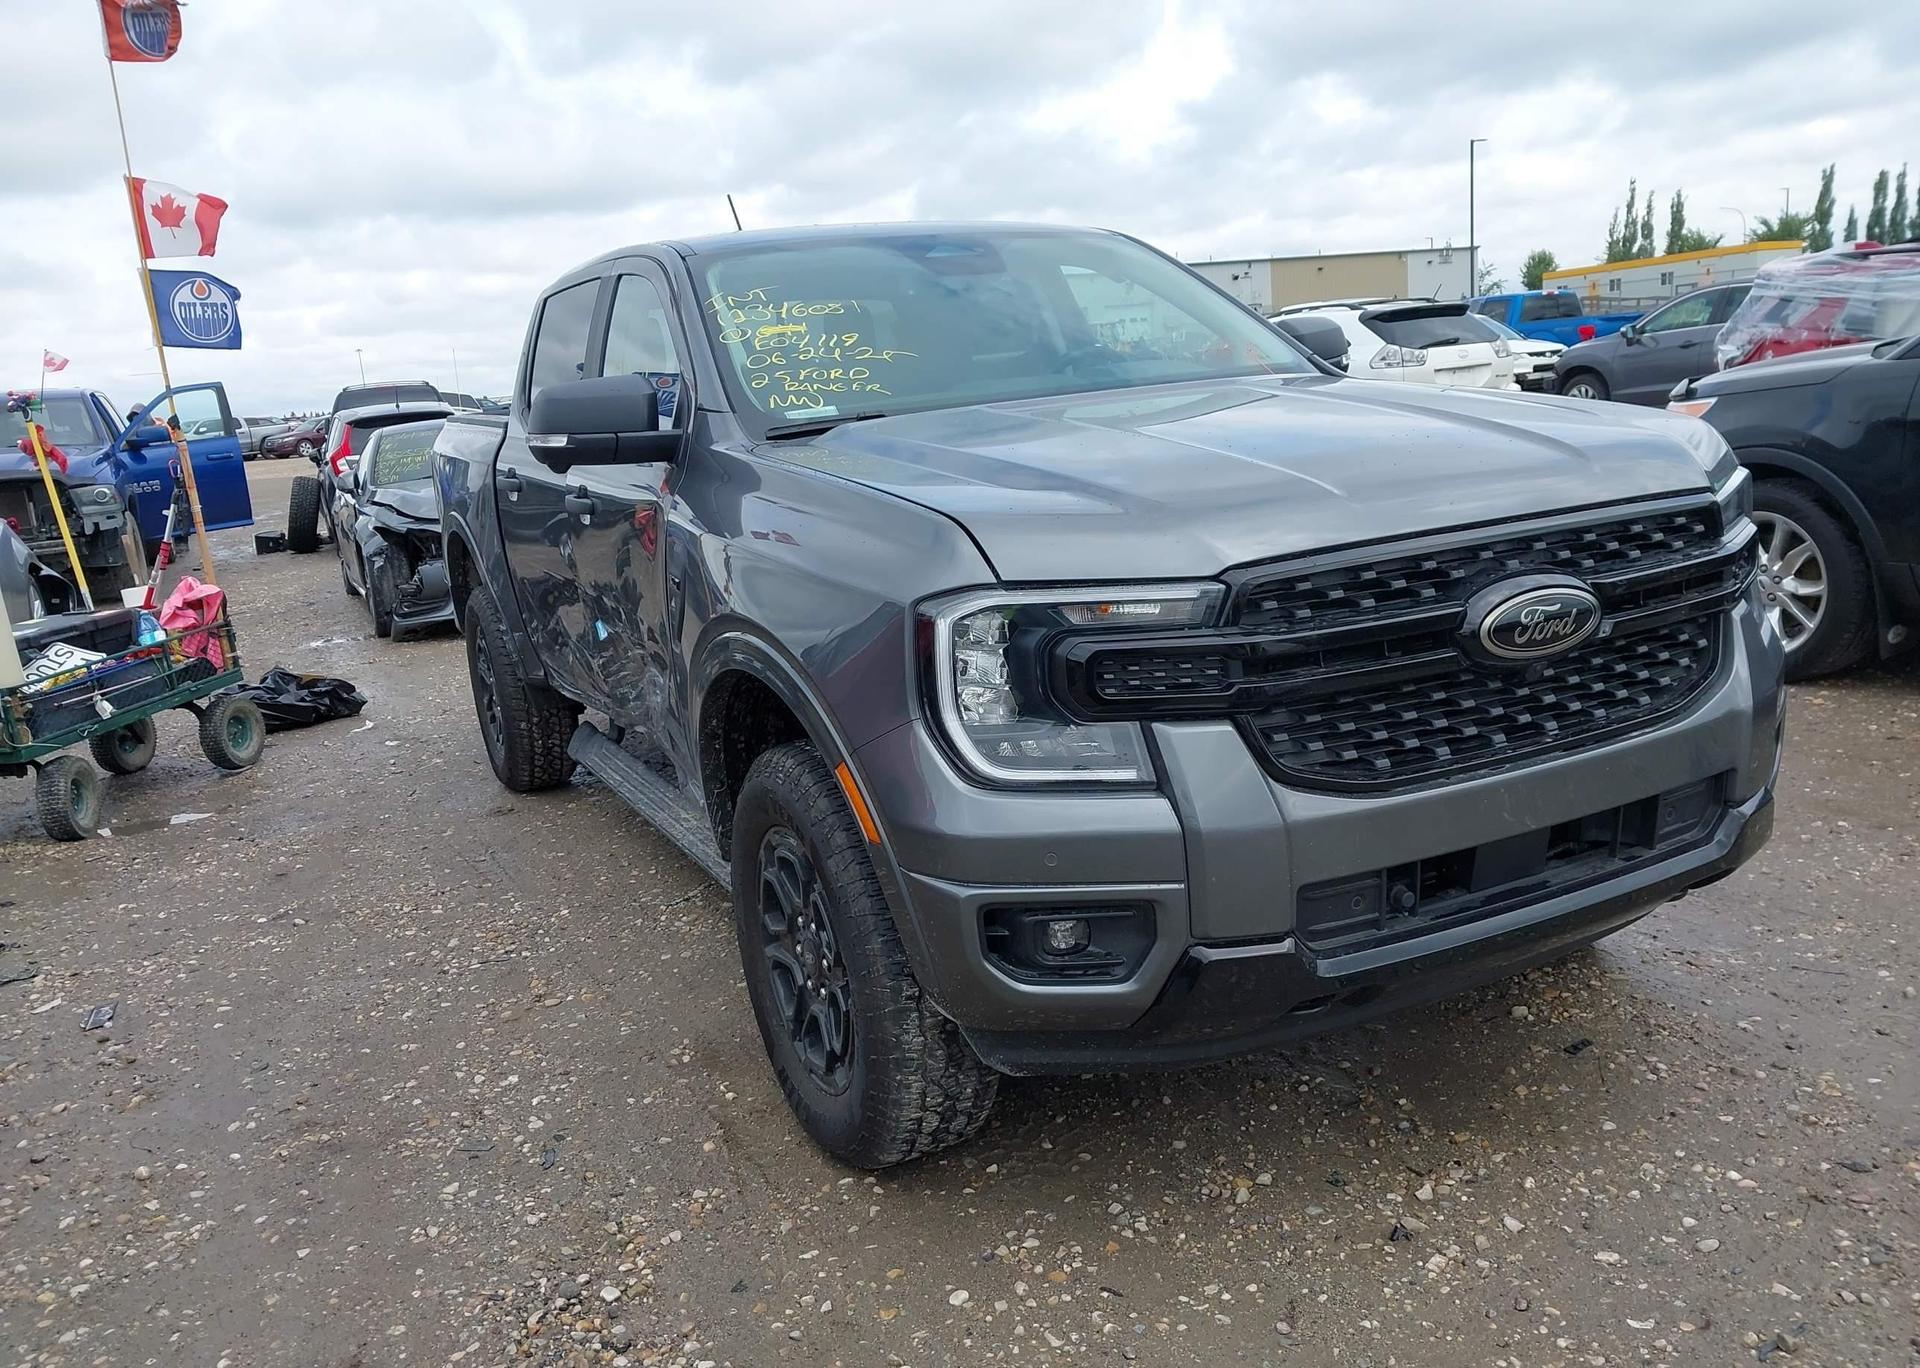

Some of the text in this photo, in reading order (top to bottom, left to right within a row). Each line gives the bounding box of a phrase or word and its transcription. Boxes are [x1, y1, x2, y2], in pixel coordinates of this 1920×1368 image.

[179, 302, 229, 331] OILERS
[800, 367, 869, 380] FORD
[1514, 603, 1577, 644] Ford
